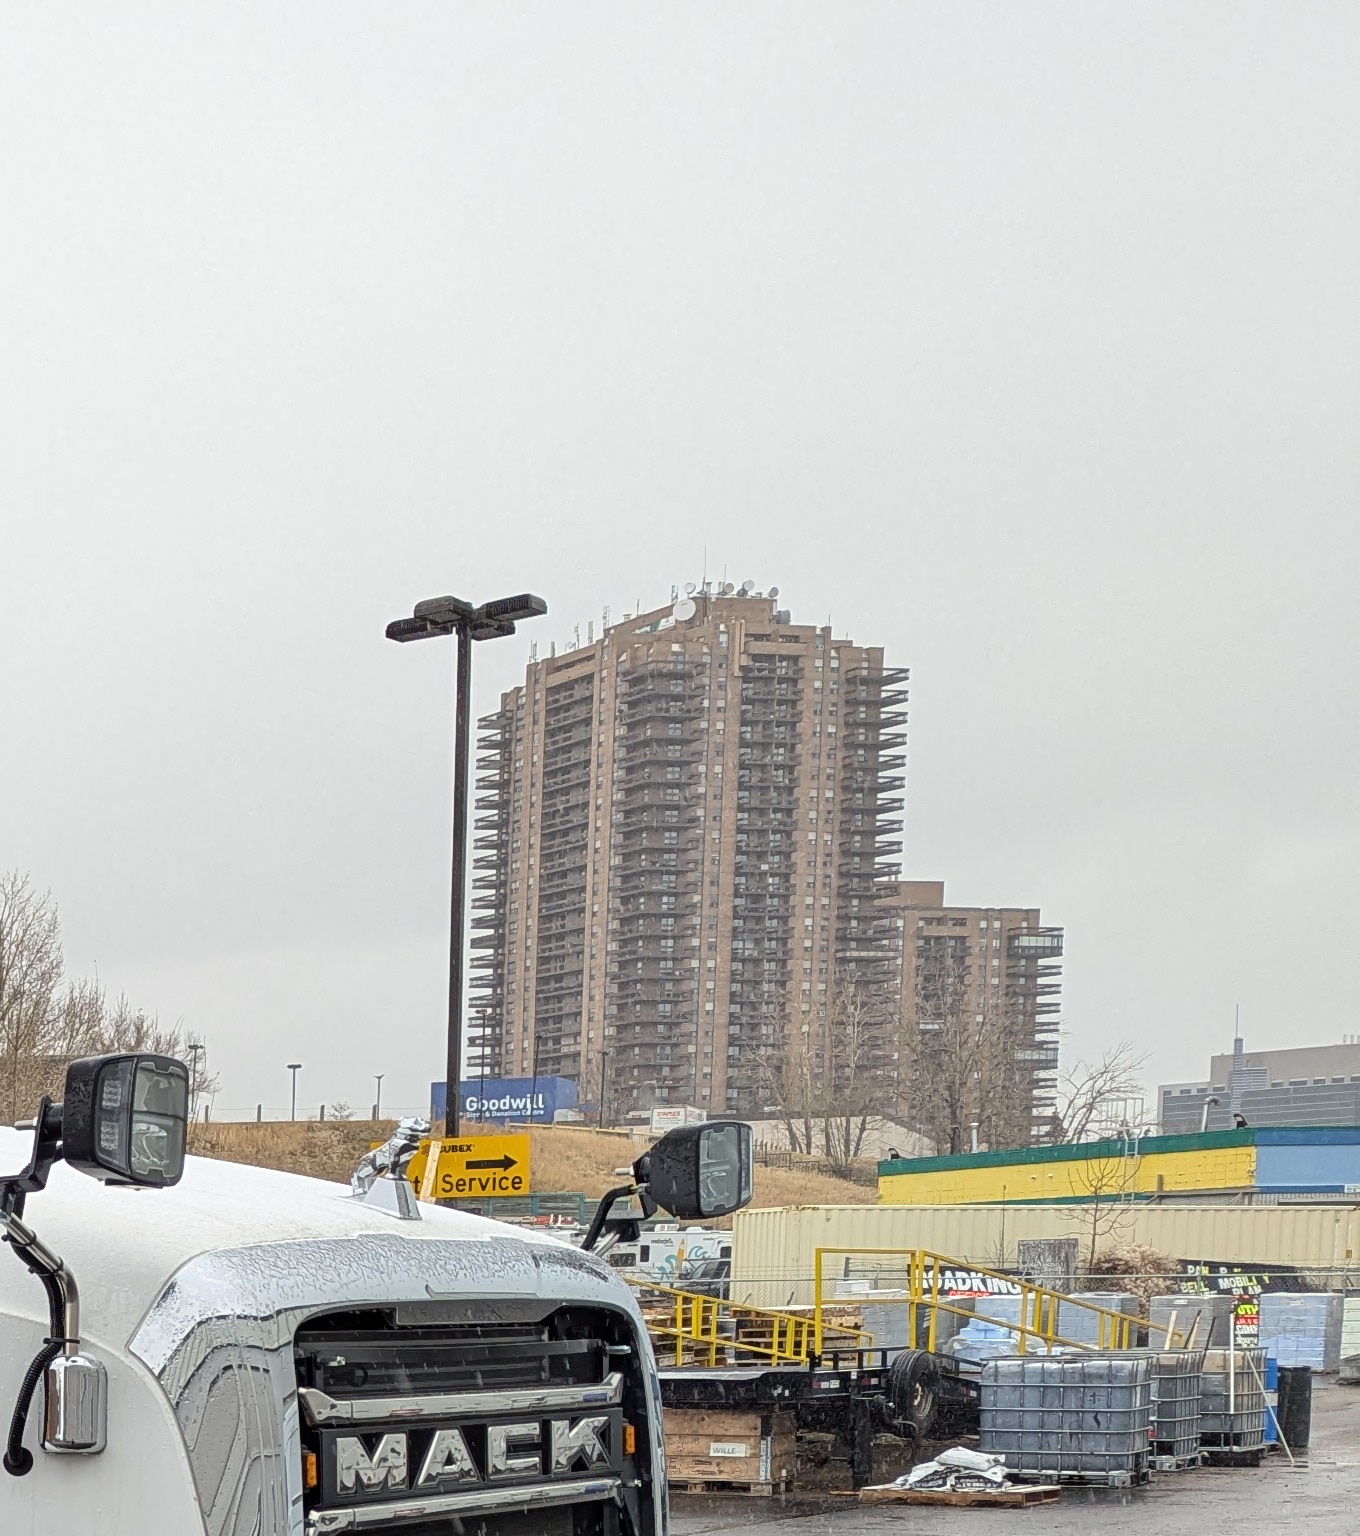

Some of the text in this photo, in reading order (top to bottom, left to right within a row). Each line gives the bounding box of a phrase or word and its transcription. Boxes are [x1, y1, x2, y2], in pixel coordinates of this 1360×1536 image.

[465, 1093, 545, 1112] Goodwill
[441, 1171, 523, 1194] Service
[1218, 1273, 1270, 1290] MOBILIY
[336, 1415, 614, 1496] MACK
